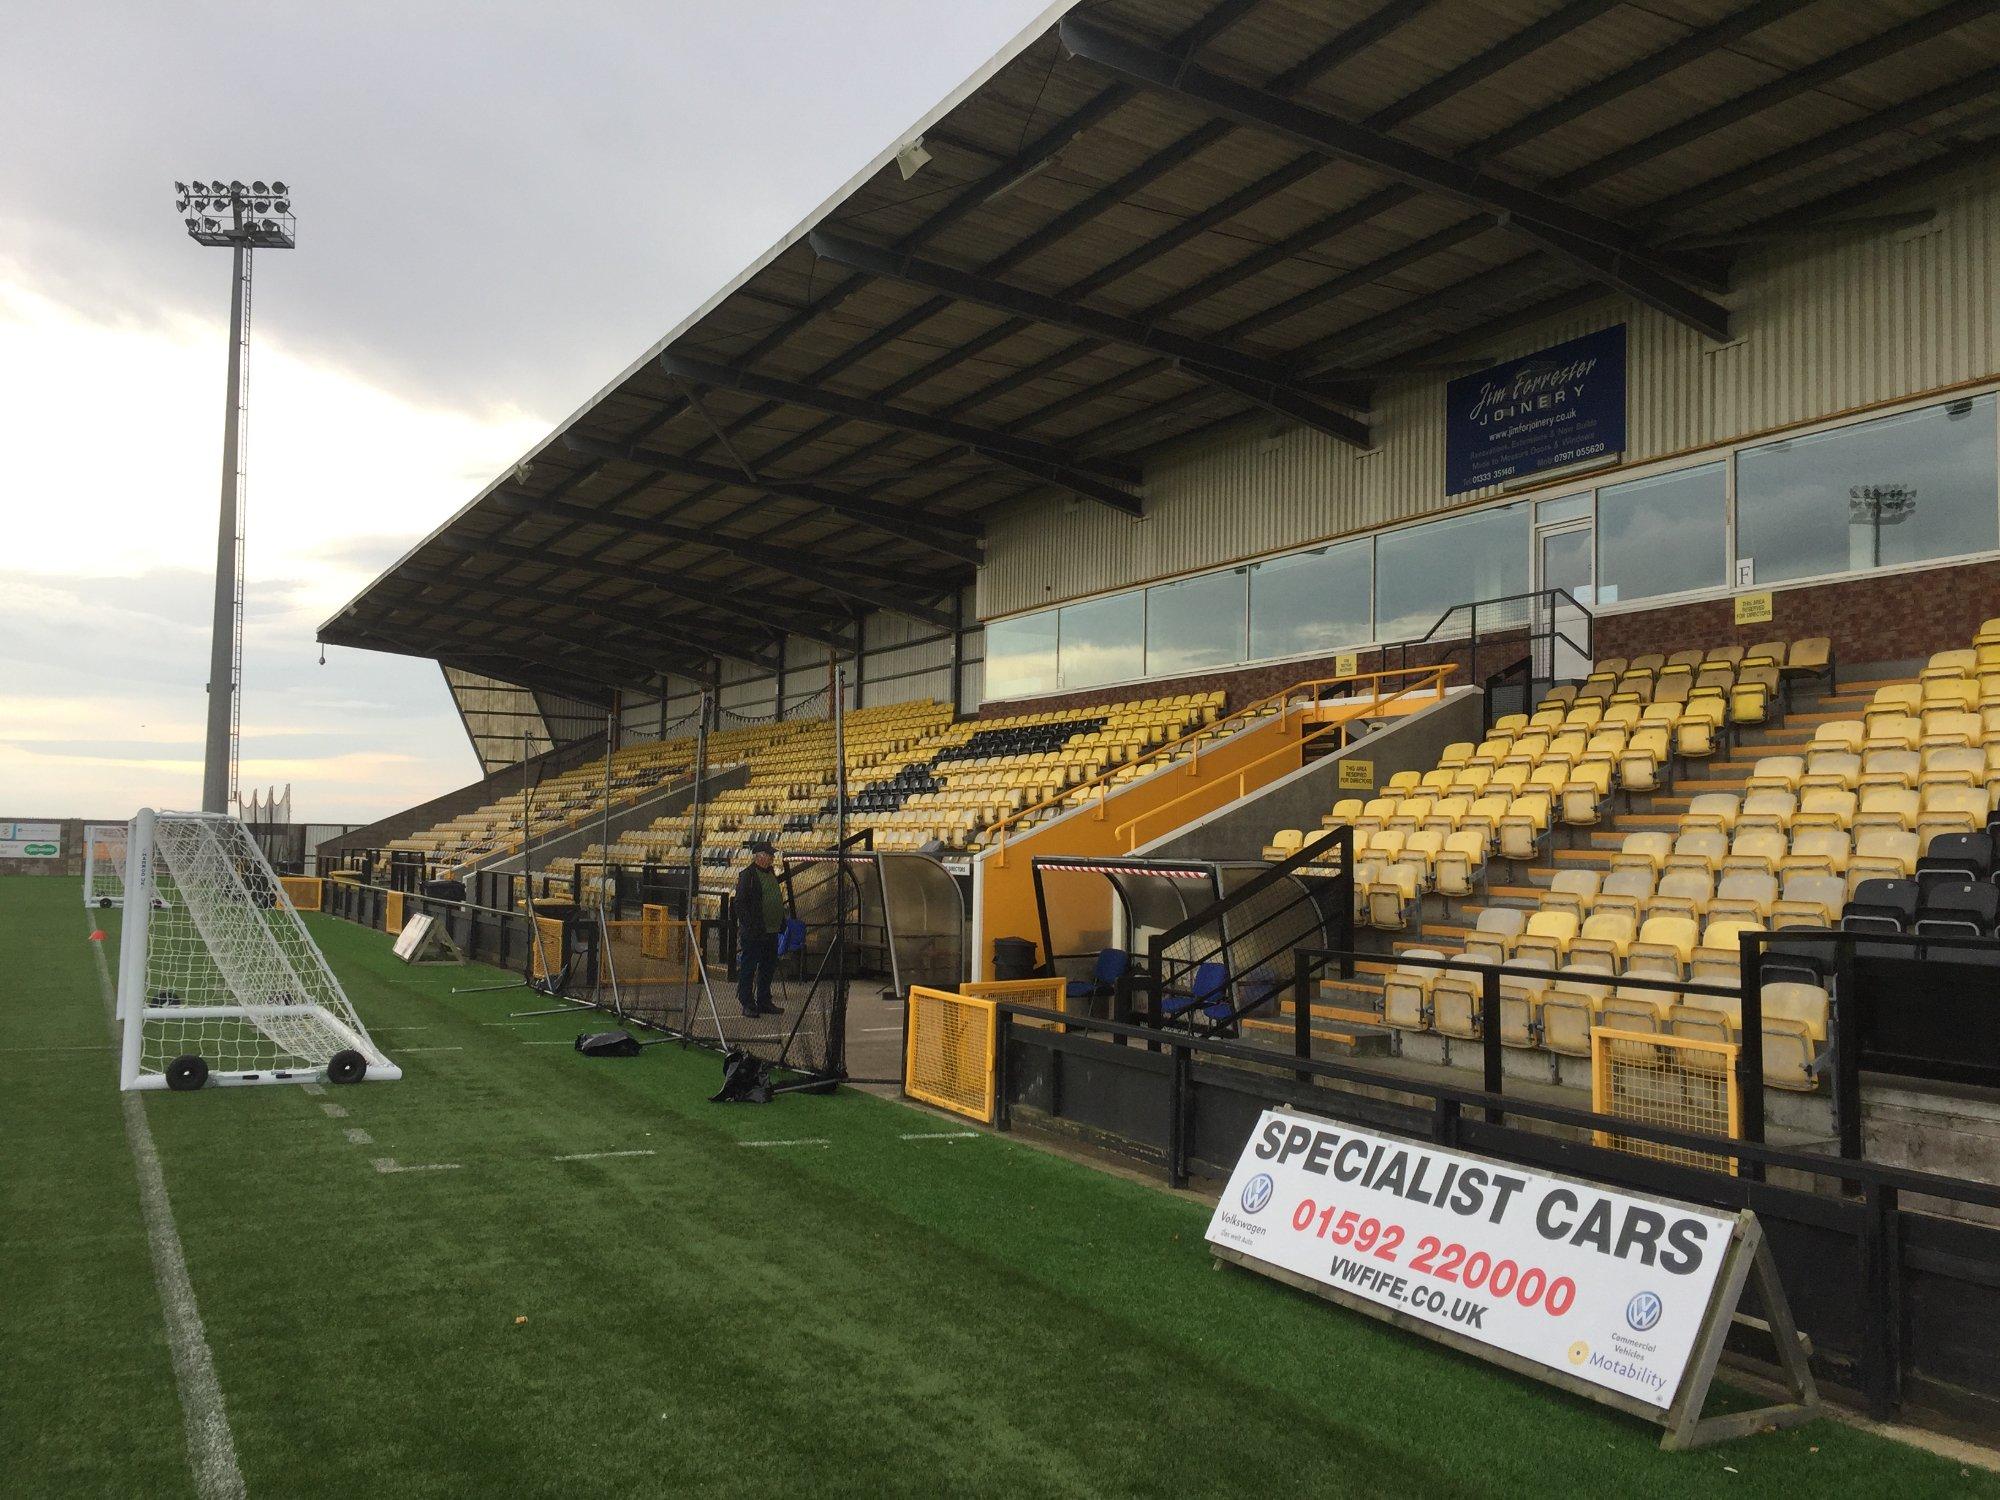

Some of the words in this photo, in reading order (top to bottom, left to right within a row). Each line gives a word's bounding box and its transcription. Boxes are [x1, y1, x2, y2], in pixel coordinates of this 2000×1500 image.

[1469, 382, 1506, 420] Jim
[1512, 358, 1597, 400] Forrester
[1480, 384, 1584, 426] JOINERY
[1489, 408, 1577, 440] www.jimforjoinery.co.uk
[1554, 450, 1574, 462] 07971
[1576, 443, 1605, 457] 055620
[1472, 472, 1492, 484] 01333
[1739, 566, 1750, 584] F
[1255, 1120, 1526, 1225] SPECIALIST
[1535, 1188, 1708, 1275] CARS
[1221, 1211, 1267, 1236] Volkswagen
[1292, 1199, 1405, 1263] 01592
[1408, 1236, 1576, 1316] 220000
[1330, 1255, 1488, 1329] VWFIFE.CO.UK
[1611, 1332, 1657, 1353] Commercial
[1614, 1344, 1645, 1361] Vehicles
[1589, 1352, 1668, 1391] Motability
